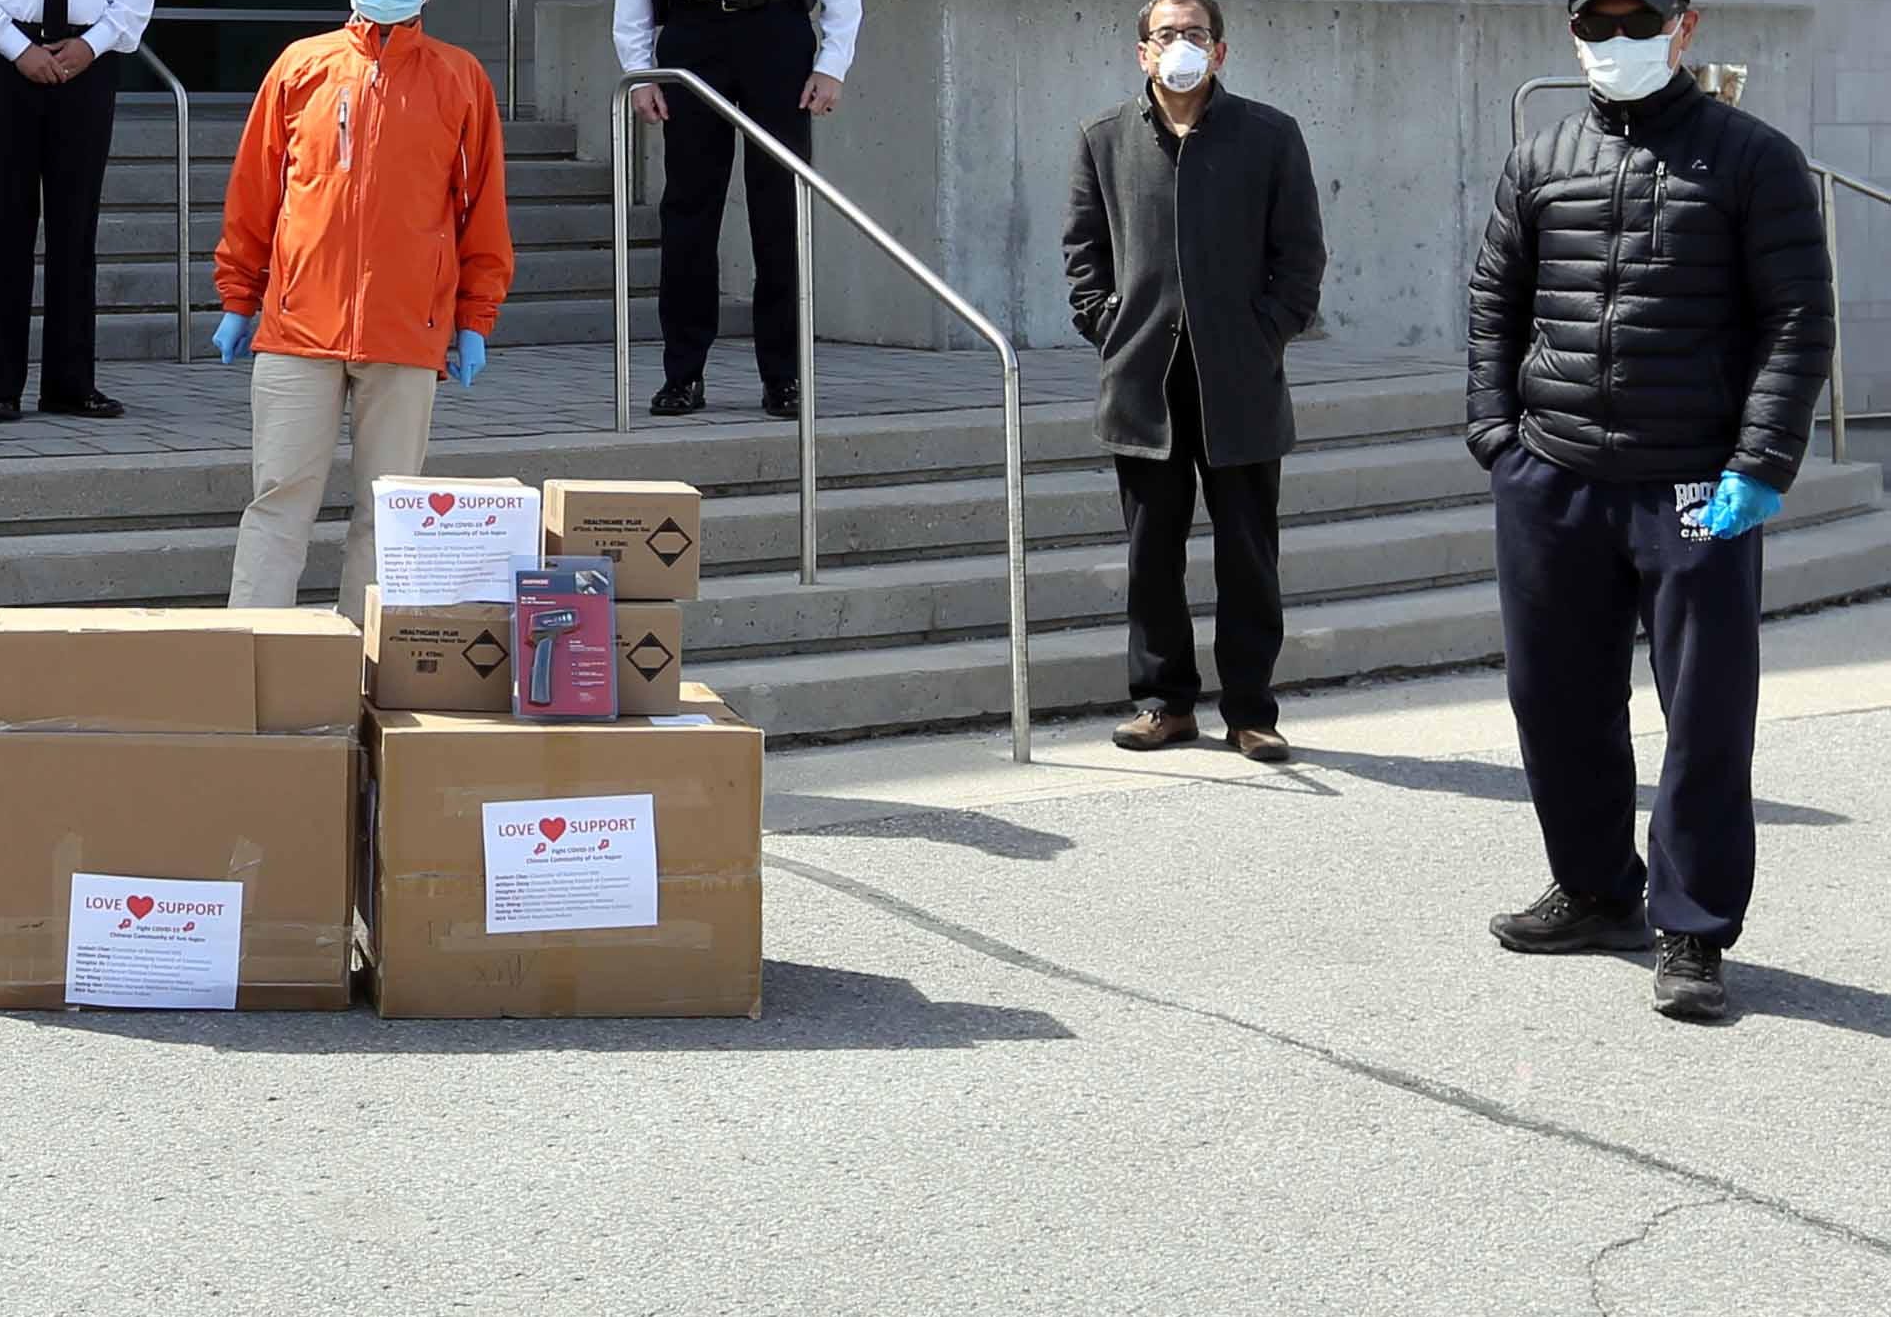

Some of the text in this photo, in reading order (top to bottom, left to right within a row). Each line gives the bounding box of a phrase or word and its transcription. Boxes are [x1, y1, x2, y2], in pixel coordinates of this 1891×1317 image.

[389, 496, 524, 509] LOVE SUPPORT
[1674, 482, 1718, 512] ROO
[1680, 528, 1710, 538] CAN
[498, 817, 636, 837] LOVE SUPPORT
[550, 855, 584, 864] Community
[85, 896, 225, 916] LOVE SUPPORT
[133, 932, 167, 941] Community
